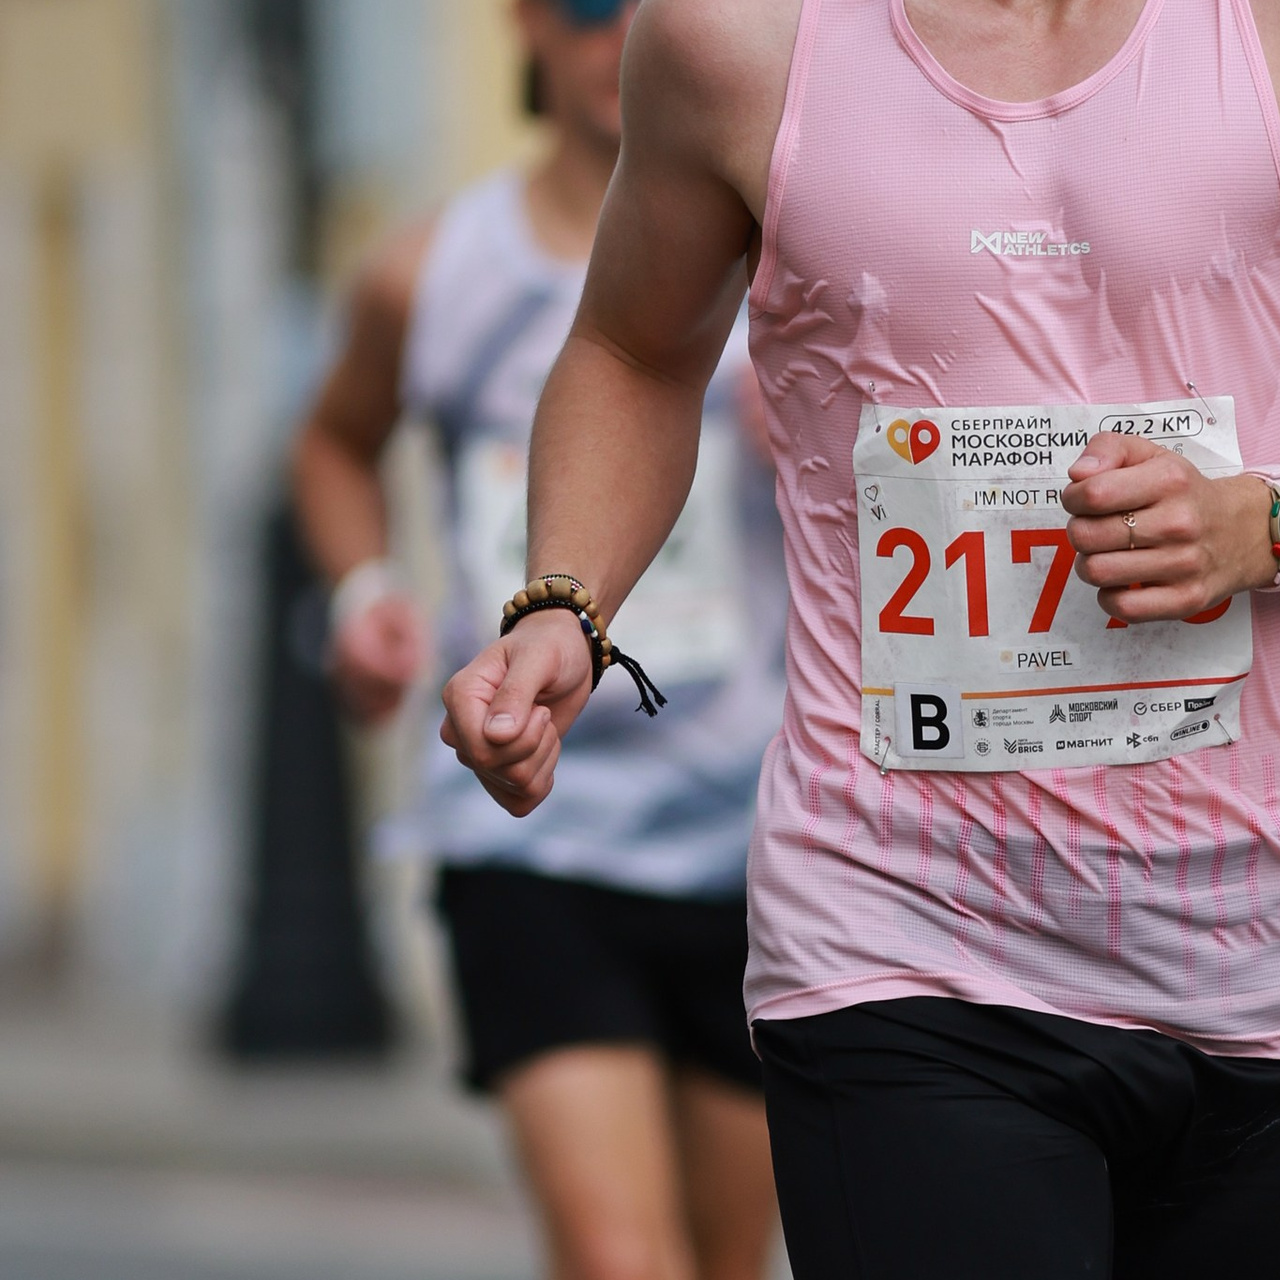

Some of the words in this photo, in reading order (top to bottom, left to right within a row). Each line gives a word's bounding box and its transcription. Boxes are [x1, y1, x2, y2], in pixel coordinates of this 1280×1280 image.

[1005, 232, 1047, 243] NEW
[951, 416, 1052, 431] СБЕРПРАЙМ
[1111, 419, 1154, 435] 42,2
[1162, 416, 1191, 432] КМ
[951, 430, 1088, 449] МОСКОВСКИЙ
[952, 451, 1052, 466] МАРАФОН
[974, 490, 997, 505] I'M
[1002, 490, 1040, 505] NOT
[1017, 651, 1073, 668] PAVEL
[1068, 698, 1119, 712] МОСКОВСКИЙ
[1150, 702, 1182, 713] СБЕР
[1069, 712, 1092, 723] СПОРТ
[1173, 724, 1201, 738] WINLINE
[1018, 745, 1043, 753] BRICS
